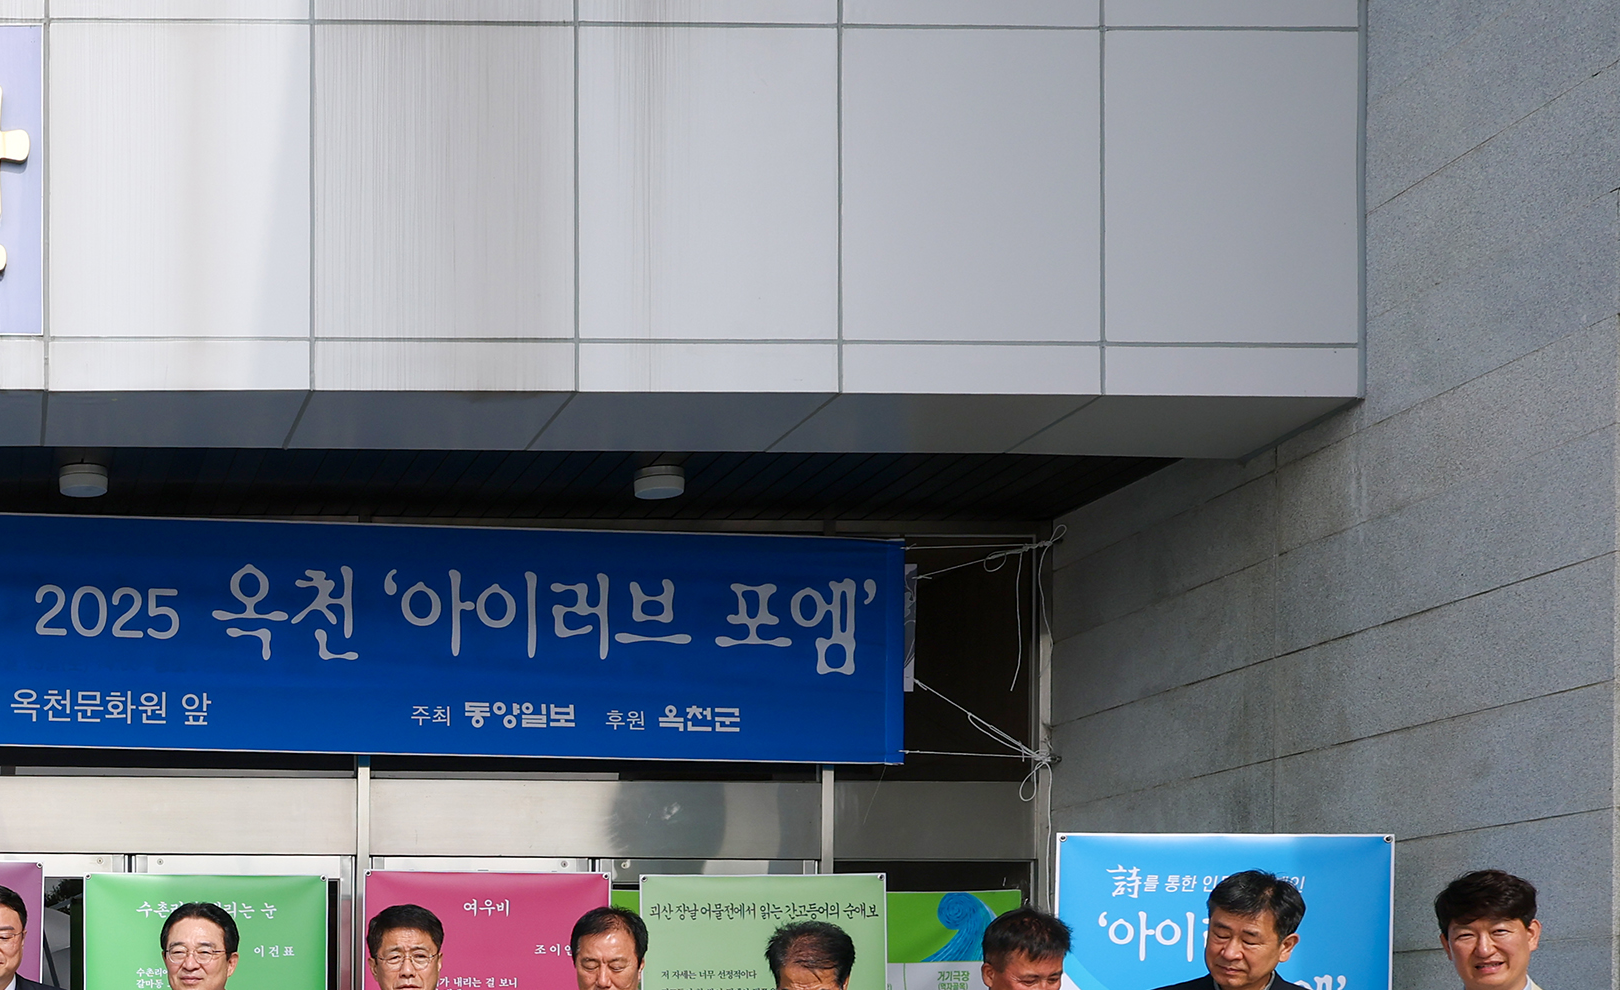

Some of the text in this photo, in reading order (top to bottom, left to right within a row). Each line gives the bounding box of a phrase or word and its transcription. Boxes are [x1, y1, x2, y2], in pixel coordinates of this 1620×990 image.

[35, 584, 180, 640] 2025
[211, 563, 359, 661] 옥천
[10, 689, 167, 725] 옥천문화원
[181, 692, 212, 726] 앞
[410, 701, 741, 733] 주최 동양일보 후원 옥천군
[1164, 874, 1198, 893] 통한
[260, 902, 277, 919] 눈
[463, 898, 510, 917] 여우비
[649, 902, 879, 921] 괴산 장날 어물전에서 읽는 간고등어의 순애보
[1097, 911, 1209, 962] ‘아이
[453, 976, 518, 988] 내리는 걸 보니
[661, 970, 758, 980] 저 자세는 너무 선정적이다
[937, 970, 971, 982] 거기극장
